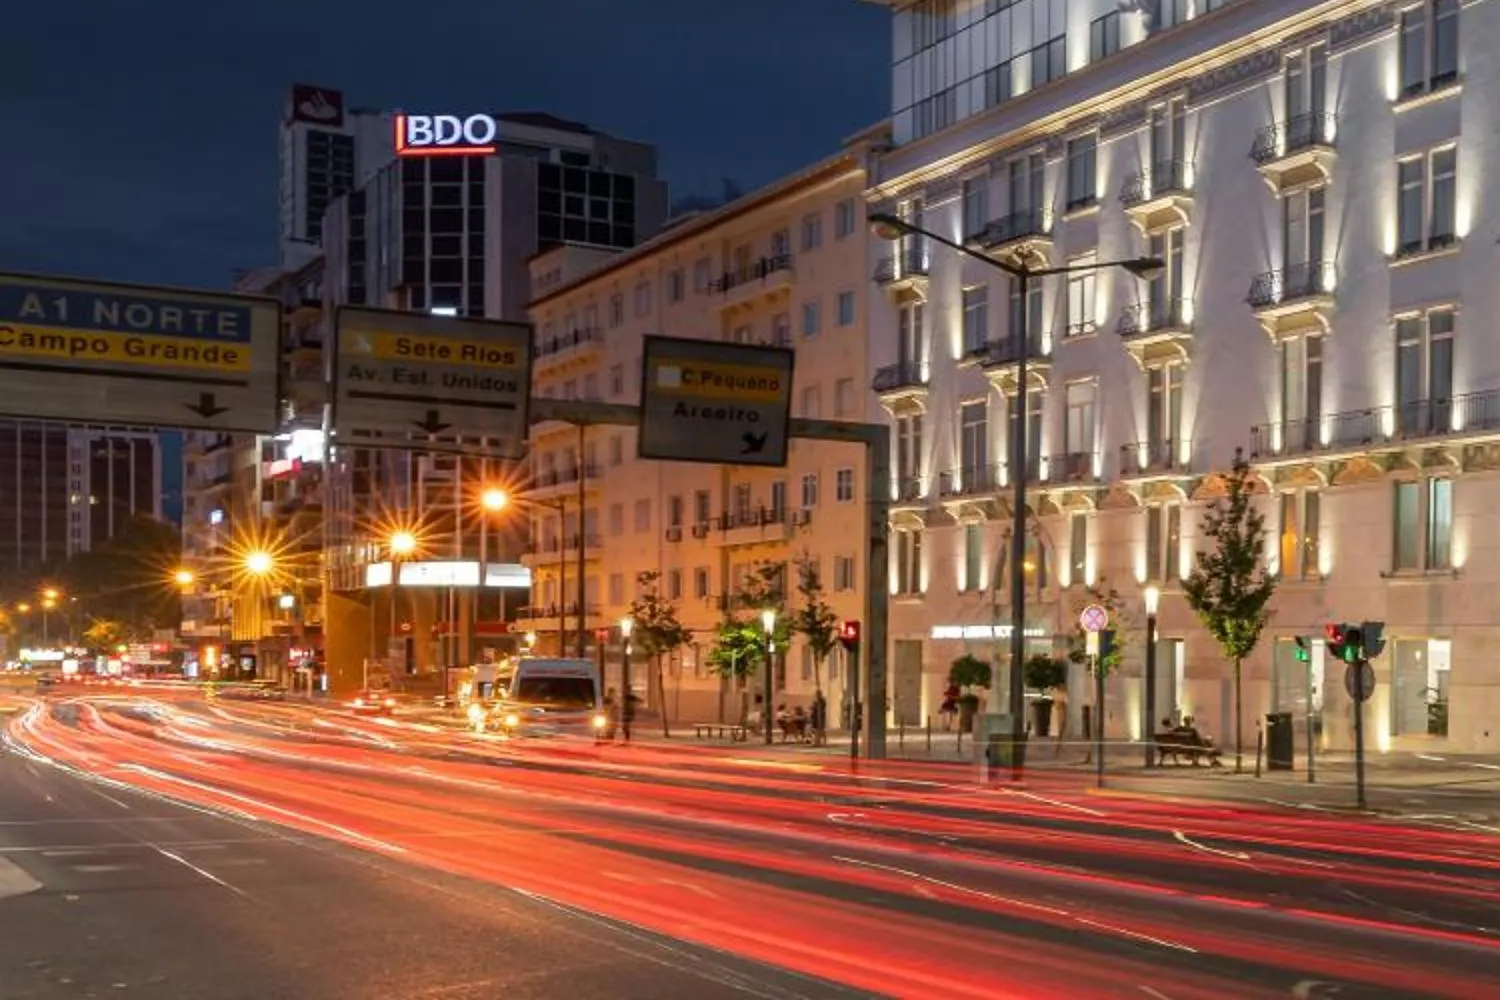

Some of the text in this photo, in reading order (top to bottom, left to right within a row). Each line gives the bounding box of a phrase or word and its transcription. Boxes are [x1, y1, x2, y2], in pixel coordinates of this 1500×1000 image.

[407, 113, 496, 145] BDO
[19, 292, 240, 336] A1 NORTE
[0, 326, 238, 364] Campo Grande
[396, 338, 515, 365] Sete Rios
[442, 373, 518, 393] Unidos
